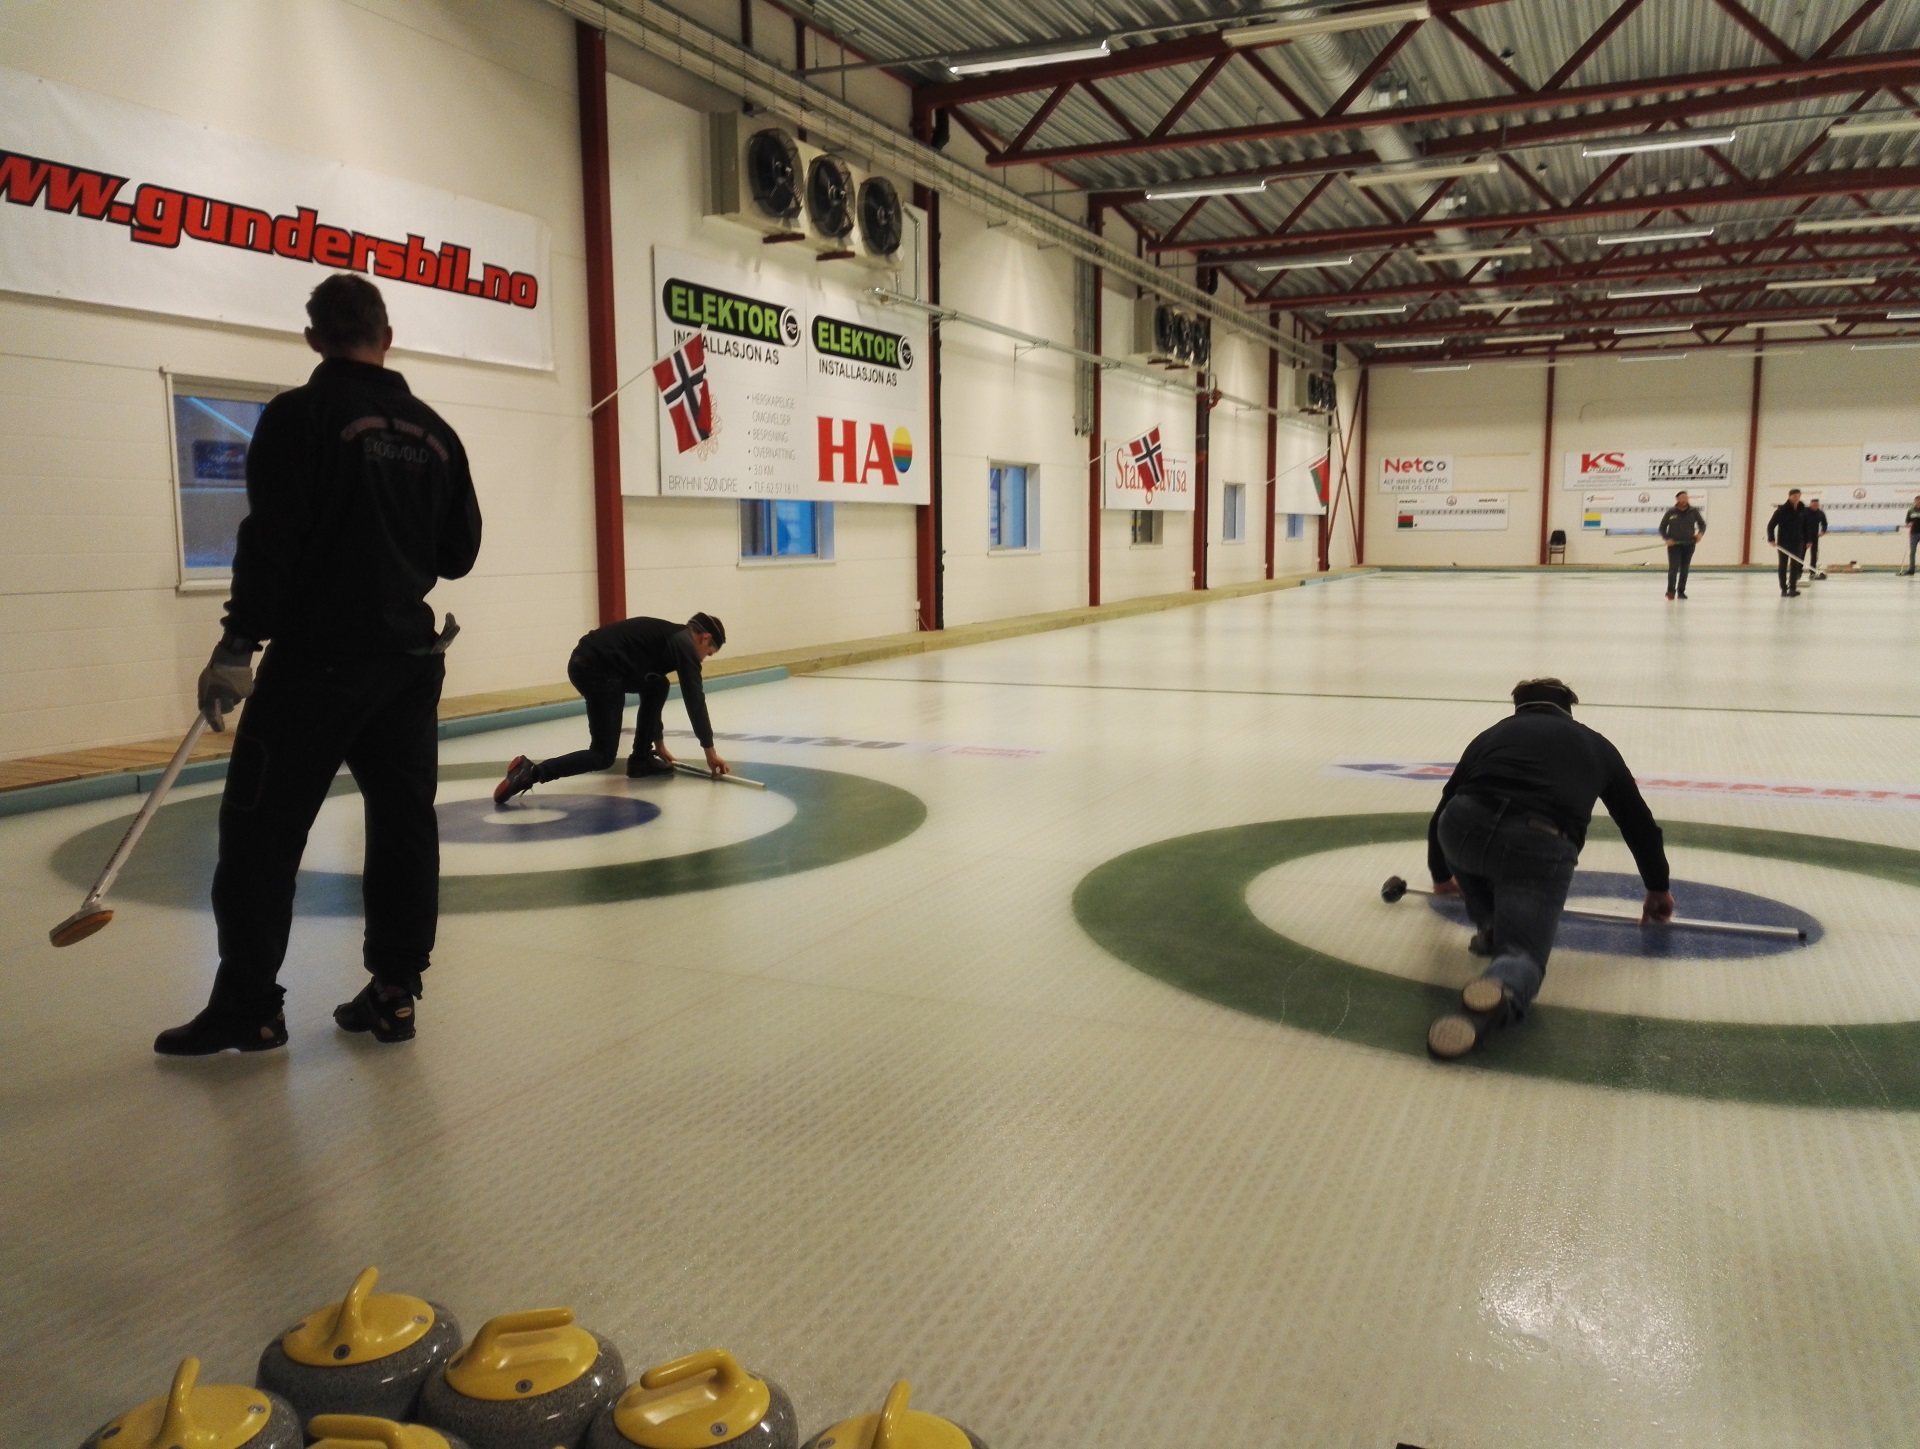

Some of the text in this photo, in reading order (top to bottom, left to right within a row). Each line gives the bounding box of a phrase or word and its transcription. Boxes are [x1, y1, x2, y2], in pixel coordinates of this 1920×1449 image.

[671, 284, 779, 340] ELEKTOR
[673, 328, 780, 366] INALLASJON AS
[817, 320, 897, 364] ELEKTOR
[818, 358, 898, 387] INSTALLASJON AS
[816, 416, 899, 486] HA
[1384, 457, 1447, 474] Netco
[1580, 451, 1626, 474] KS
[668, 475, 738, 494] BRYHNI SØNDRE
[1649, 463, 1719, 477] HANSTAD
